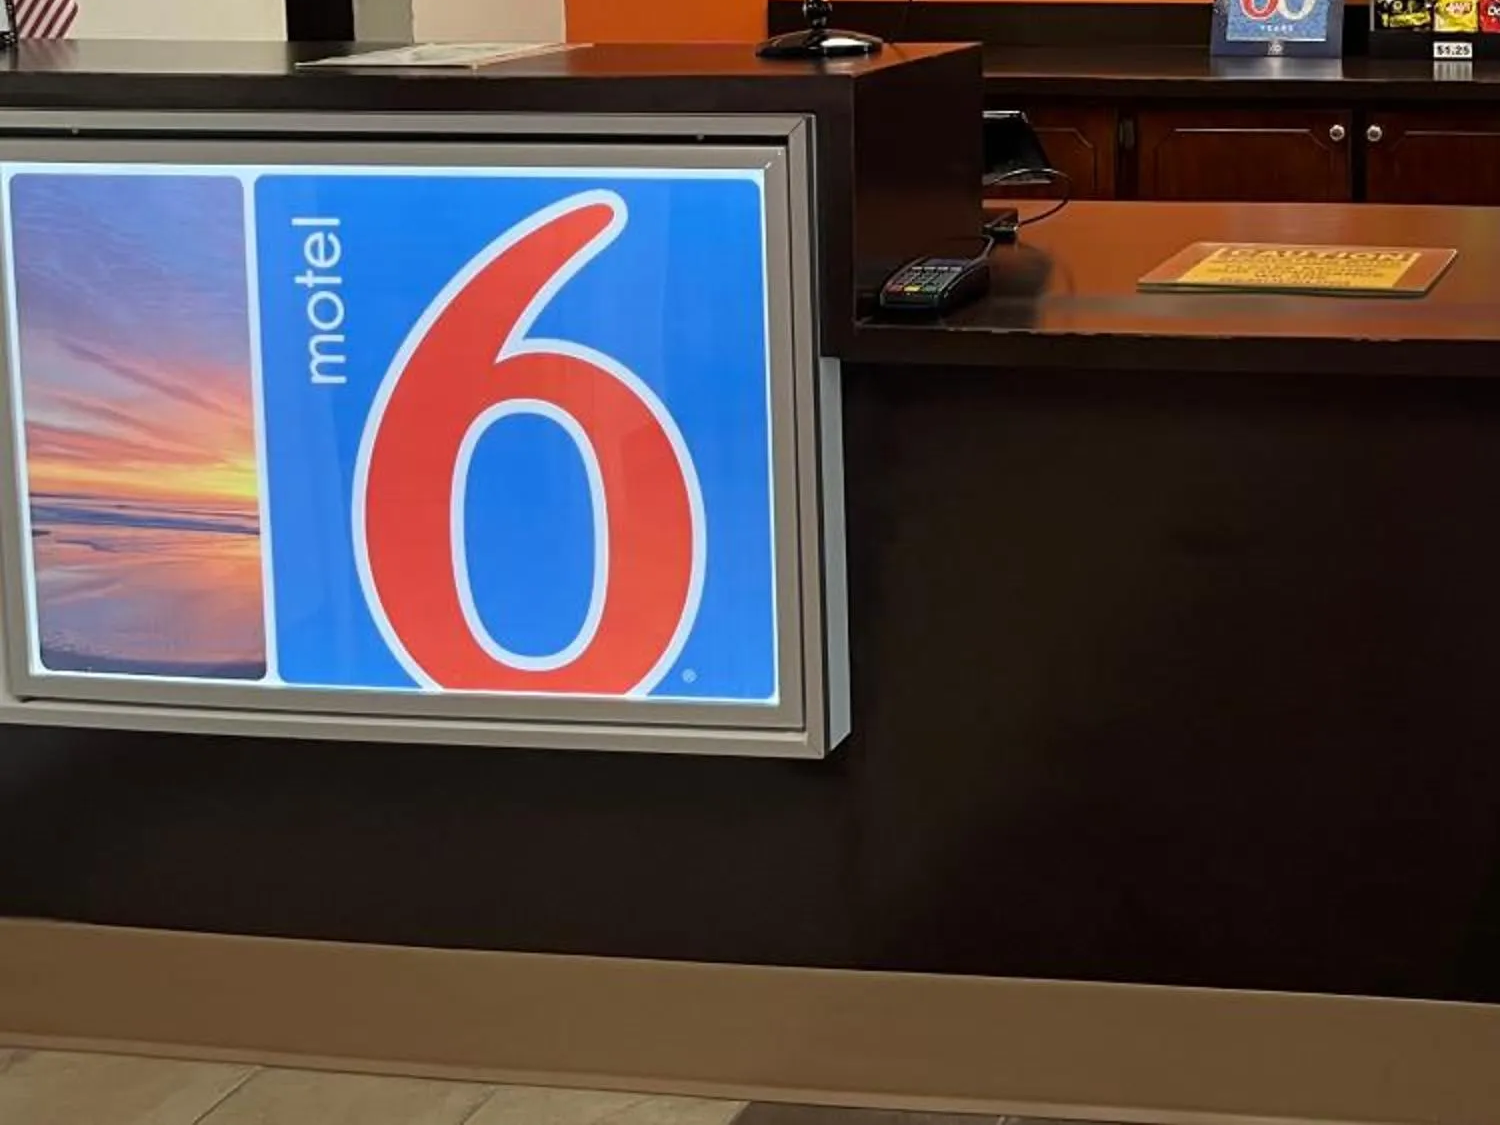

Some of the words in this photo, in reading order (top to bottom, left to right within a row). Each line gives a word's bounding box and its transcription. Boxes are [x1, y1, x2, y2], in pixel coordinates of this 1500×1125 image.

[1436, 45, 1470, 56] $1.25
[291, 215, 347, 387] motel
[352, 189, 708, 696] 6
